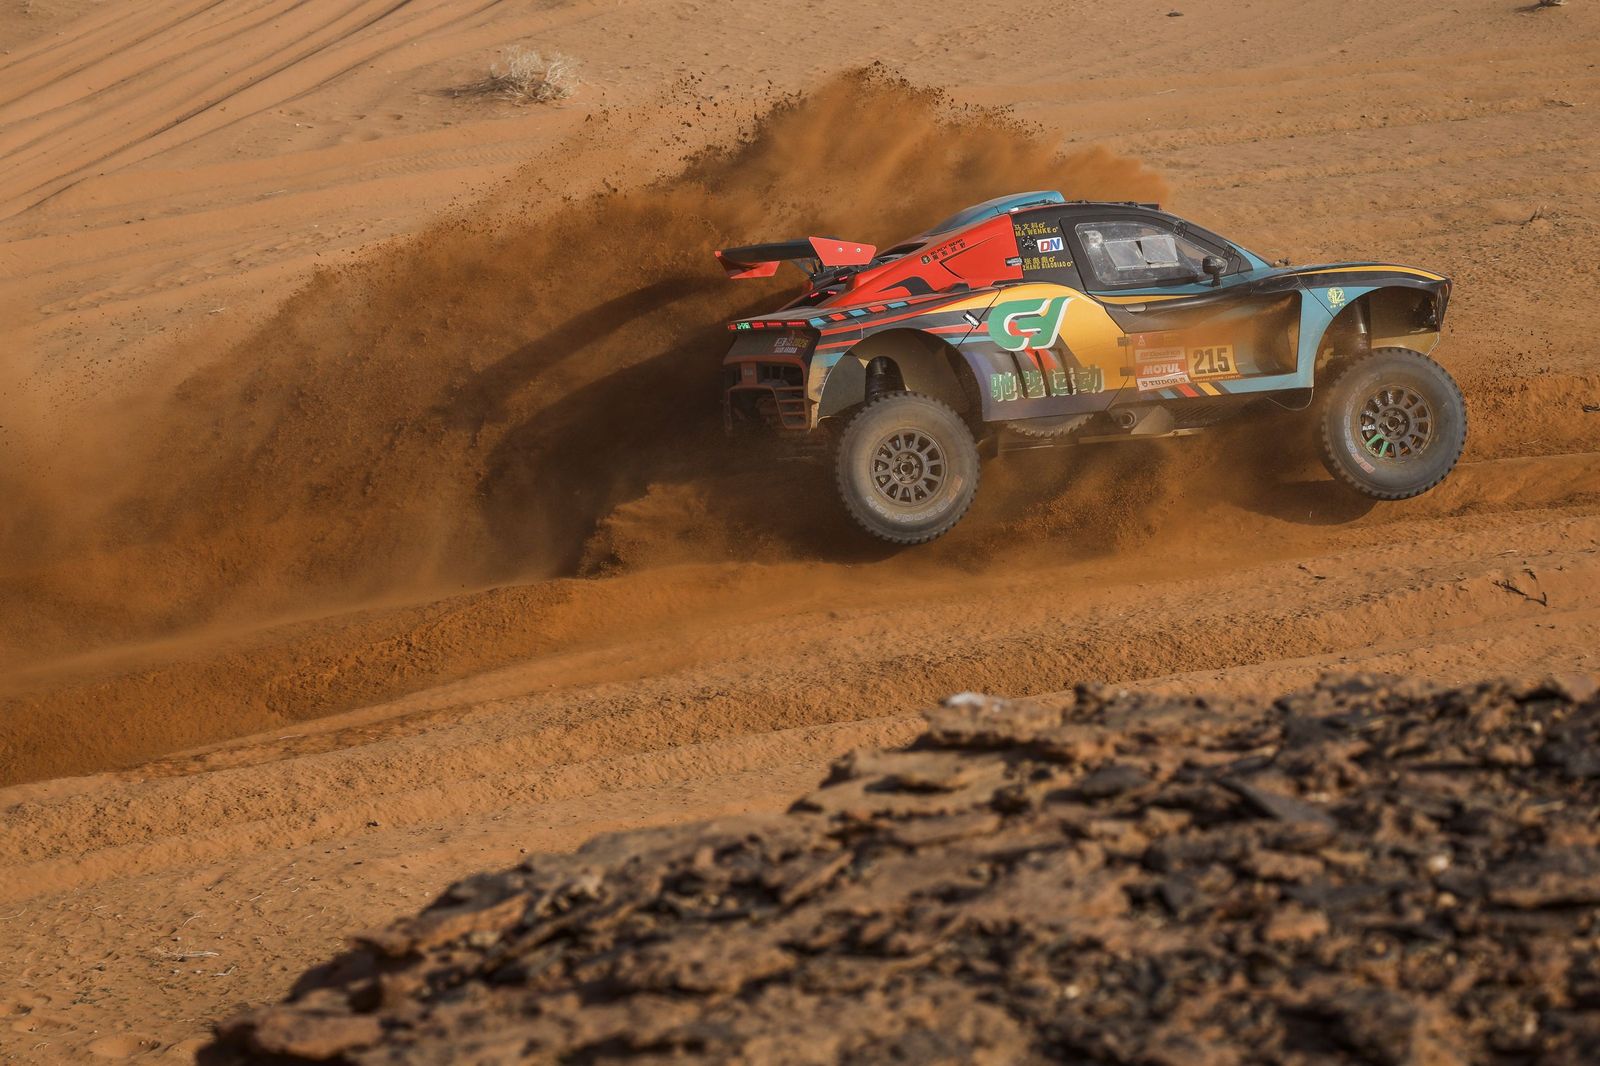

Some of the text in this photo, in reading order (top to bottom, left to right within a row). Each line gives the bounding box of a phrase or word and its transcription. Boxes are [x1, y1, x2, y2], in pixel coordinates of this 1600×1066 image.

[1015, 229, 1025, 237] MA
[1027, 227, 1052, 235] WENKE
[1040, 238, 1061, 252] DN
[1193, 347, 1230, 375] 215
[1142, 363, 1181, 375] MOTUL
[1148, 378, 1178, 387] TUDOR
